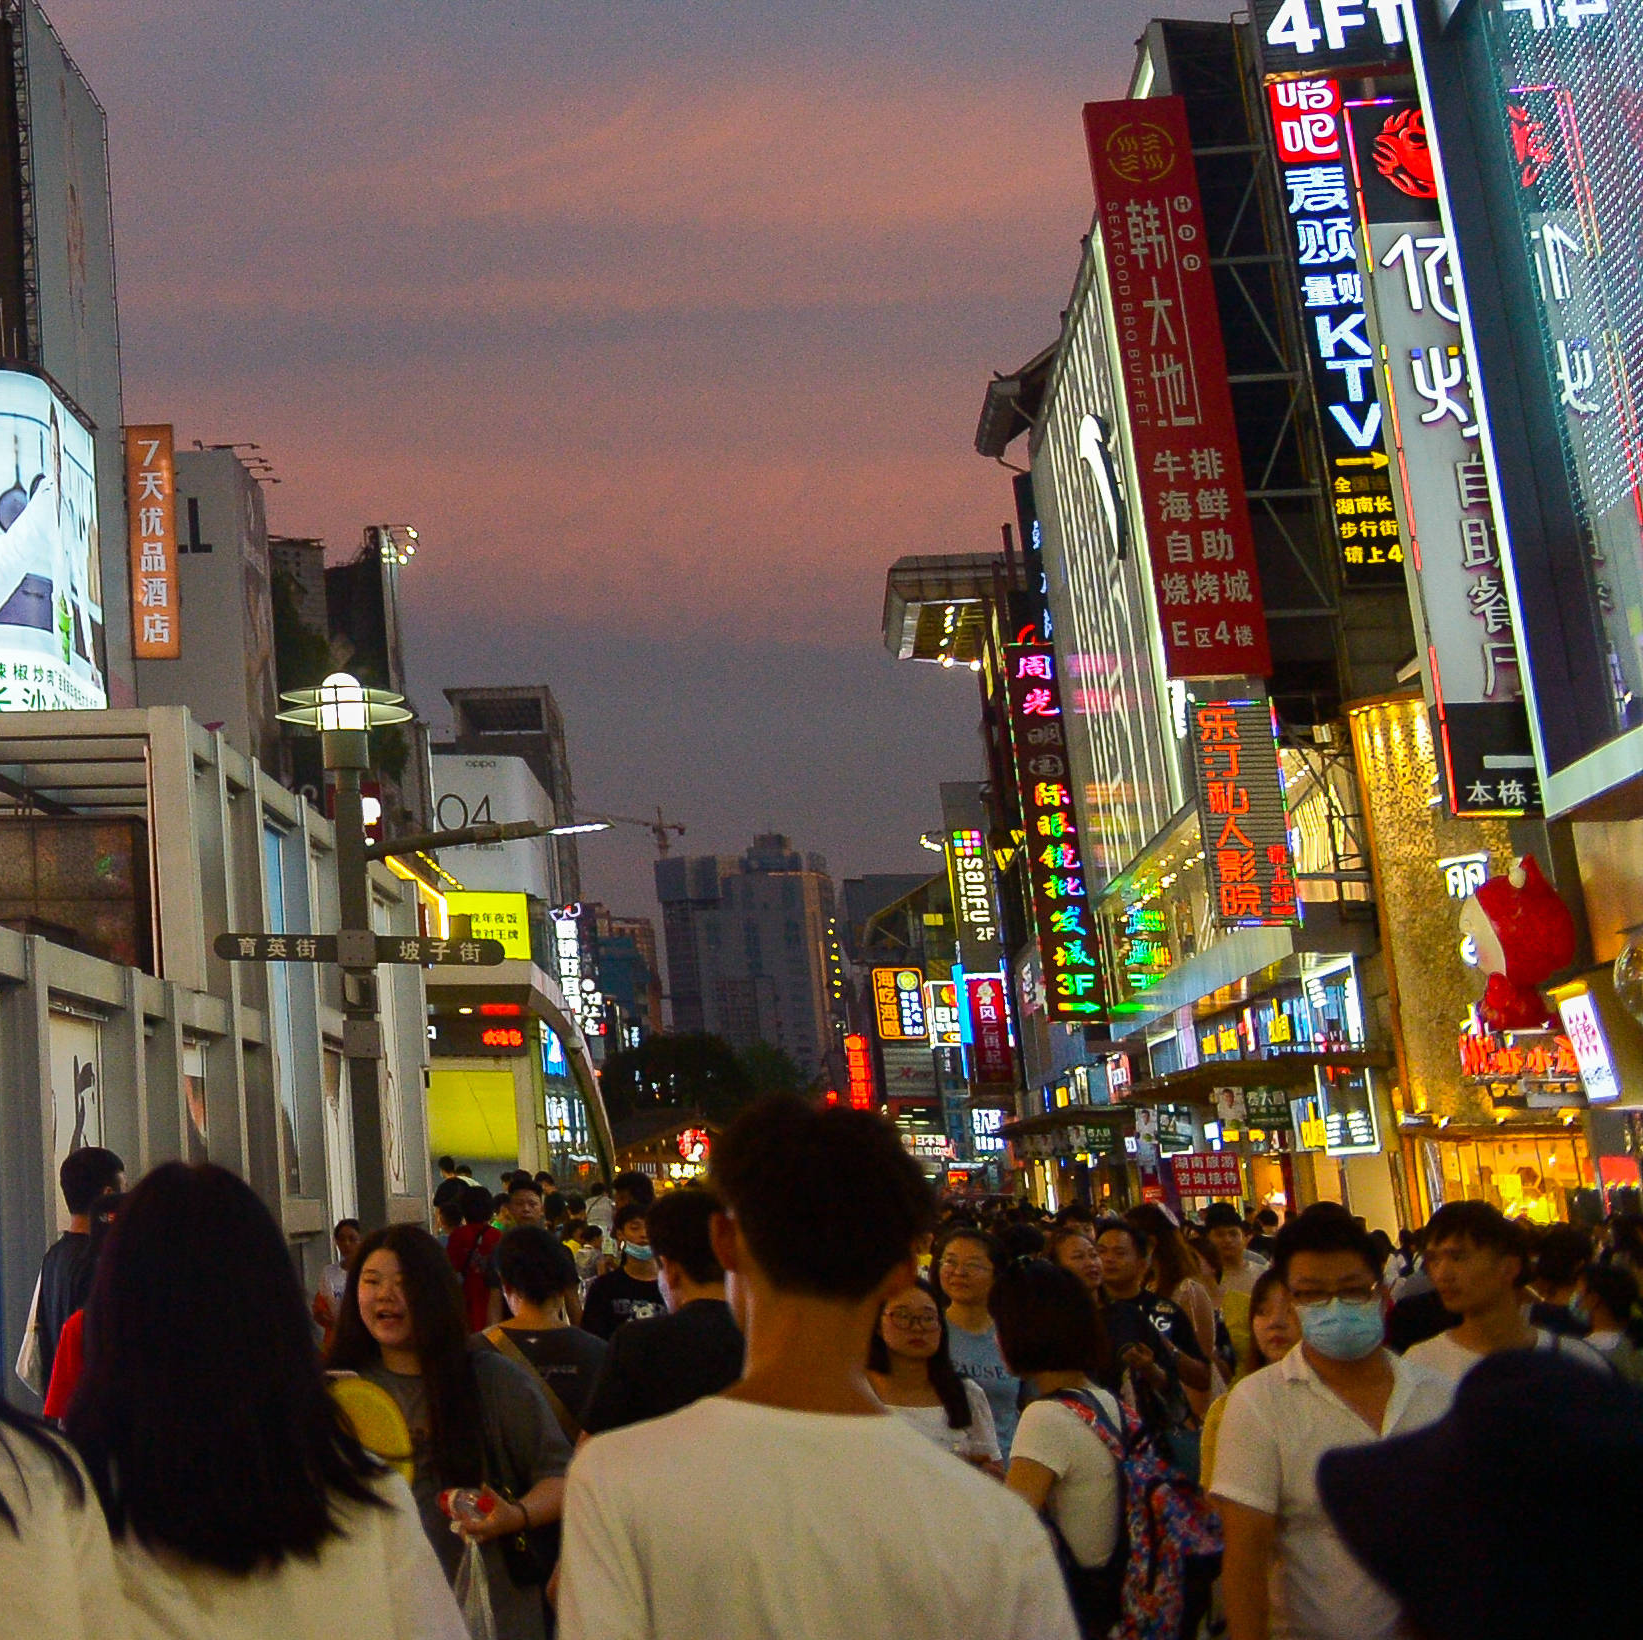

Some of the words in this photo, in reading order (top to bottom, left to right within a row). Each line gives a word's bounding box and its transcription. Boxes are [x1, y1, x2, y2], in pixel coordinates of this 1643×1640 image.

[1315, 314, 1381, 450] KTV
[1153, 451, 1225, 482] 牛排
[1157, 490, 1231, 522] 海鲜
[139, 437, 173, 645] 7天优品酒店
[1166, 530, 1235, 563] 自助
[1163, 571, 1253, 606] 烧烤城
[1171, 619, 1255, 648] E区4楼
[237, 936, 317, 959] 育英街
[976, 926, 996, 942] 2F
[398, 940, 482, 963] 坡子街
